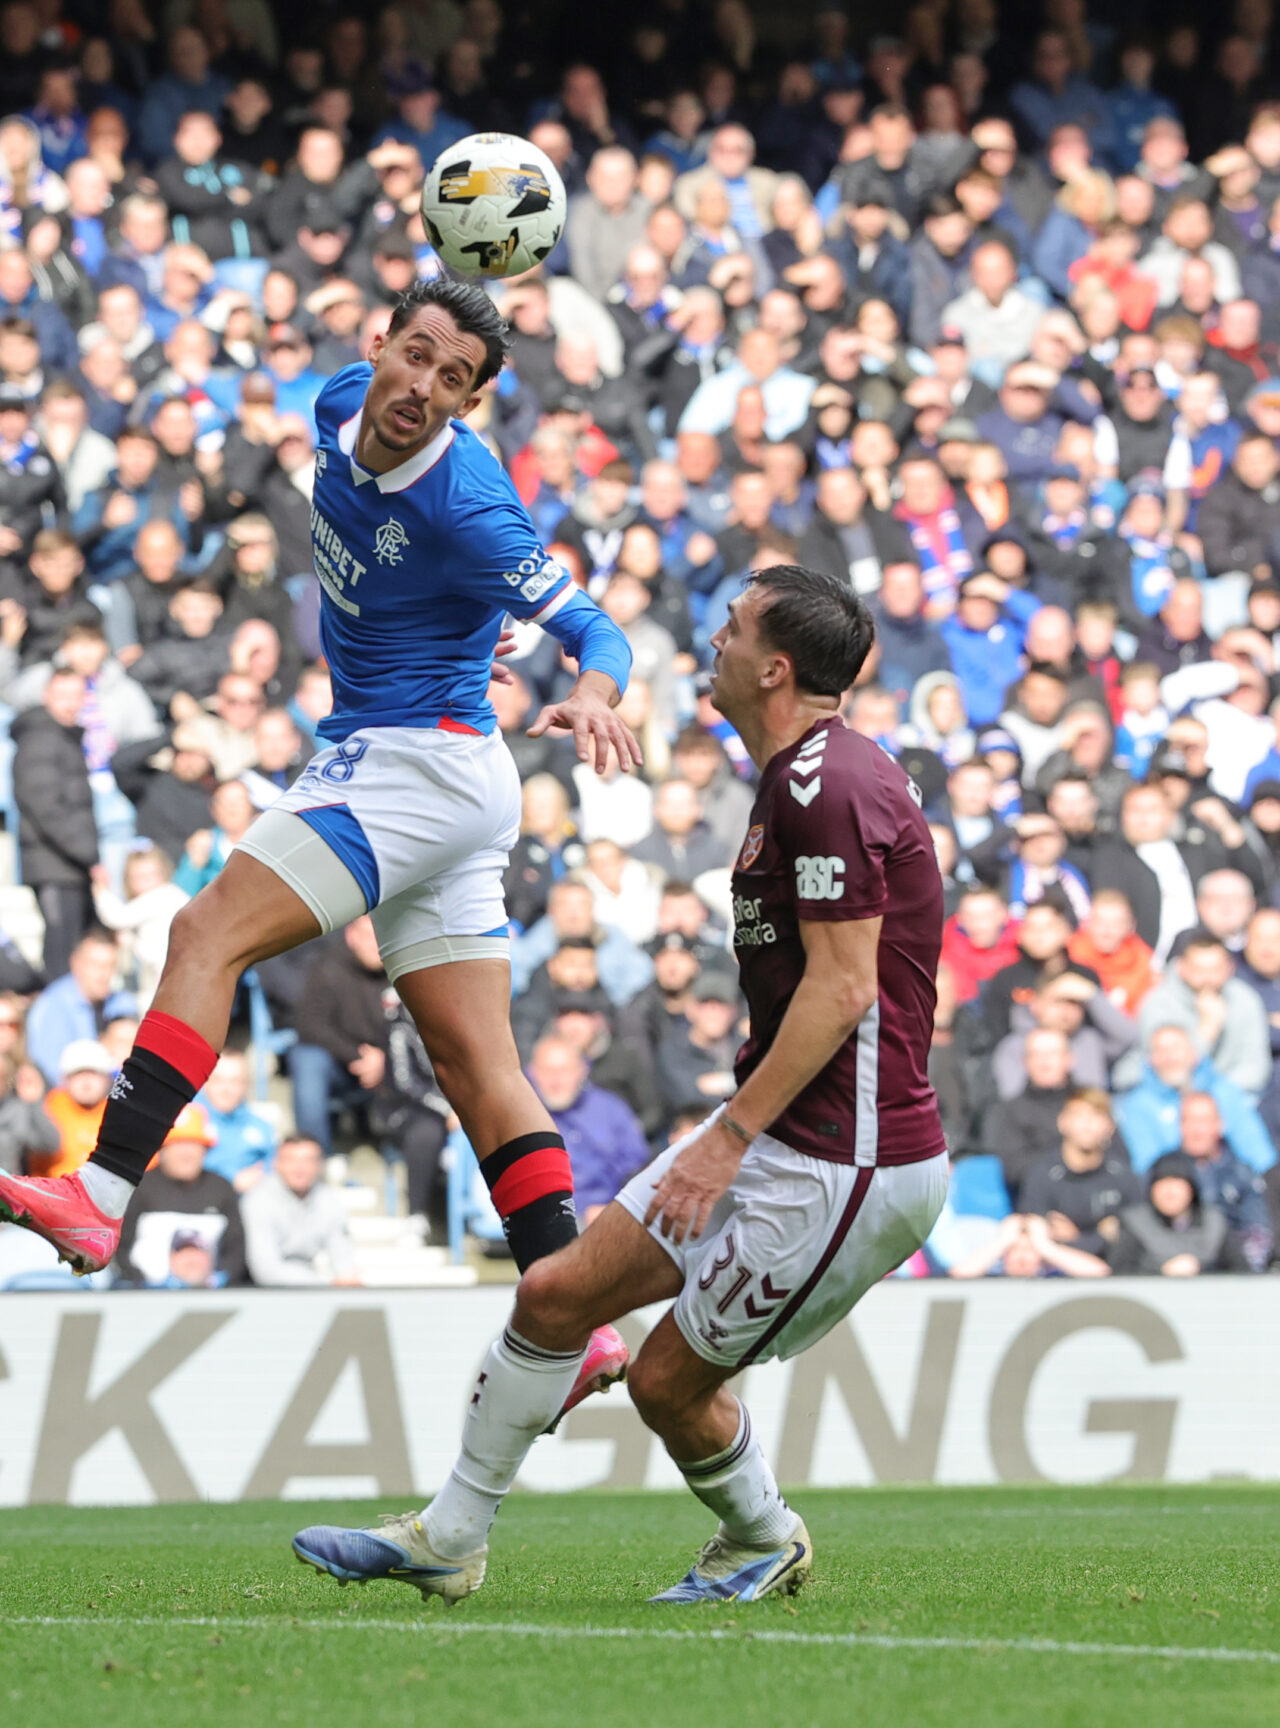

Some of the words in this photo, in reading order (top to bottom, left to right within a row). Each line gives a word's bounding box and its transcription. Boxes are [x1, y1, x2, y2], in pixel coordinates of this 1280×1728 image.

[311, 503, 367, 587] UNIBET
[306, 738, 370, 783] 8
[699, 1233, 752, 1315] 31
